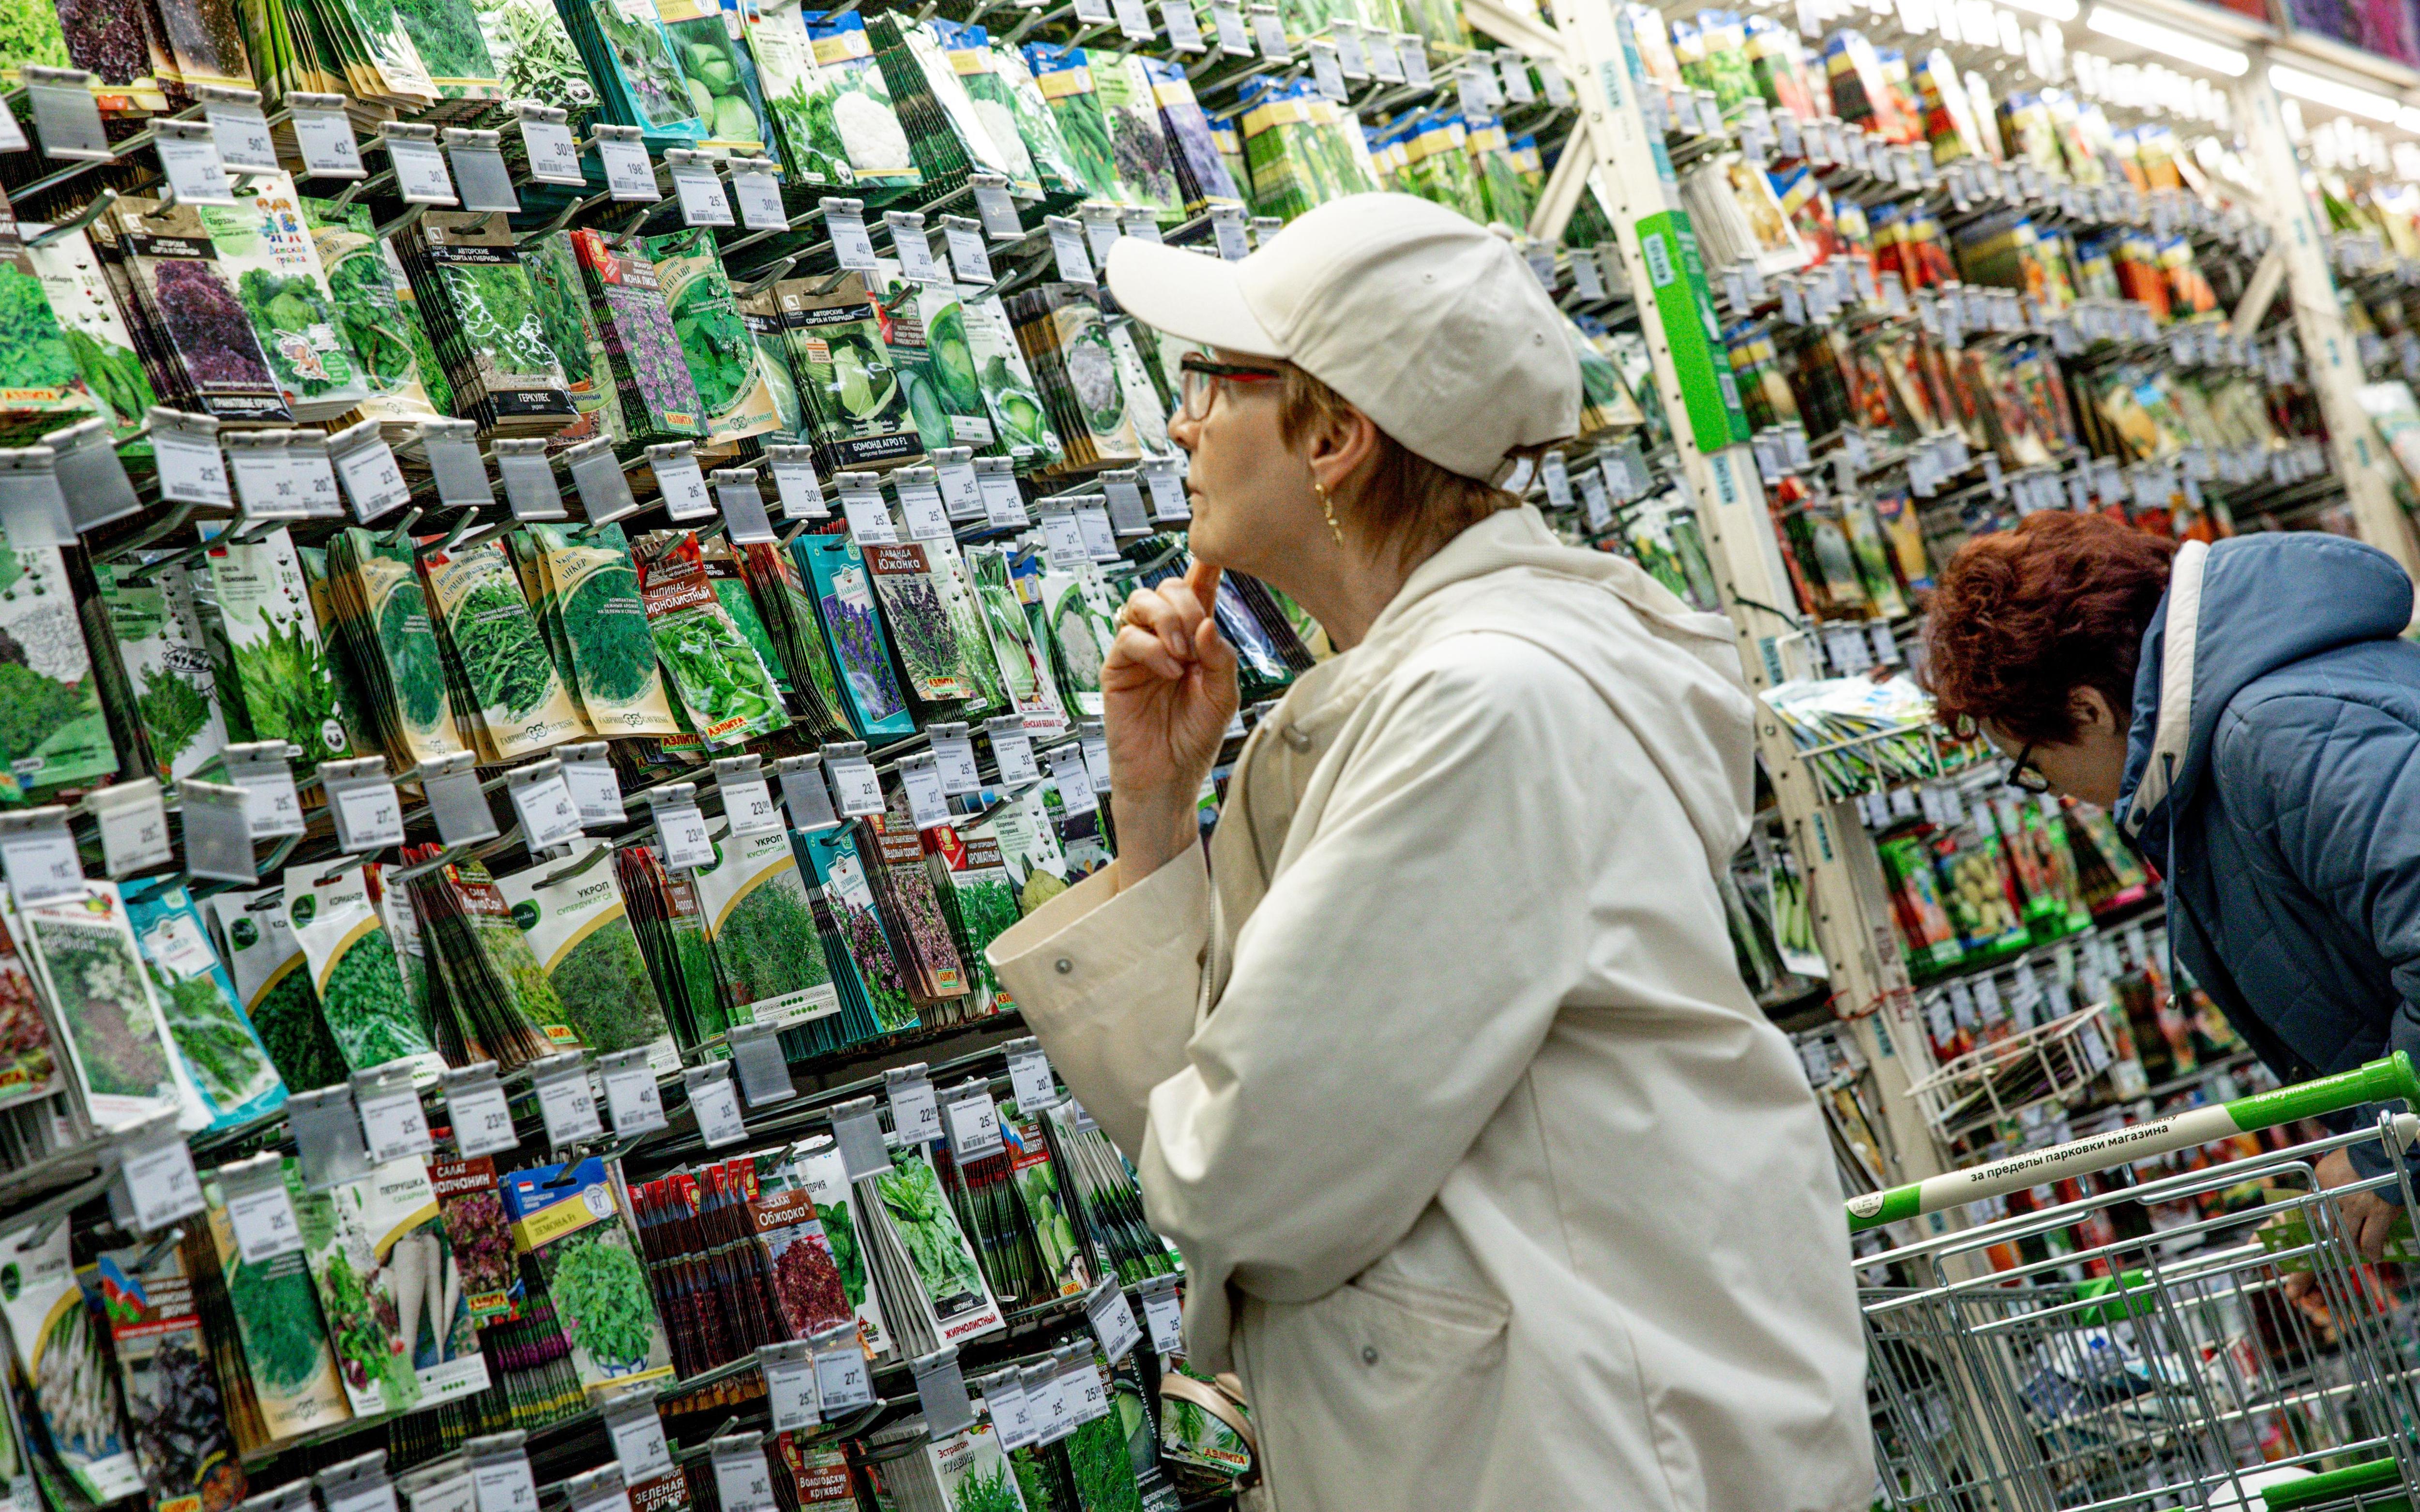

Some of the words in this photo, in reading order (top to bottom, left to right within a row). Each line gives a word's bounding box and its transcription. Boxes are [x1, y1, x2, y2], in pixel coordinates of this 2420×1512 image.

[622, 274, 641, 284] МОНА
[642, 278, 659, 288] ЛИЗА
[813, 309, 843, 318] АВТОРСКИЕ
[518, 392, 550, 403] ГЕРКУЛЕС
[667, 414, 694, 426] АЭЛИТА
[853, 442, 878, 451] БОМОНД
[879, 440, 895, 449] АГРО
[879, 548, 911, 558] ЛАВАНДА
[878, 557, 921, 570] Южанка
[650, 581, 685, 598] ШПИНАТ
[929, 677, 955, 687] АЭЛИТА
[598, 715, 624, 725] ГАВРИШ
[641, 715, 667, 724] GAVRISH
[707, 716, 748, 738] АЭЛИТА
[663, 733, 702, 746] АЭЛИТА
[999, 827, 1019, 836] лягушка
[755, 834, 783, 848] УКРОП
[747, 843, 786, 859] КУСТИСТЫЙ
[968, 851, 1001, 865] АРОМАТНЫЙ
[577, 881, 609, 898] УКРОП
[938, 972, 955, 982] АЭЛИТА
[2255, 1075, 2344, 1103] leroymerlin.ru
[1970, 1171, 1984, 1182] за
[1987, 1156, 2043, 1179] пределы
[2045, 1140, 2106, 1162] парковки
[2107, 1124, 2169, 1147] магазина
[437, 1162, 467, 1177] САЛАТ
[379, 1177, 427, 1197] ПЕТРУШКА
[769, 1195, 791, 1208] САЛАТ
[759, 1205, 805, 1227] Обжорка
[1062, 1283, 1080, 1294] АЭЛИТА
[953, 1299, 974, 1312] ШПИНАТ
[944, 1314, 997, 1340] ЖИРНОЛИСТНЫЙ
[937, 1439, 969, 1459] Эстрагон
[942, 1451, 975, 1474] ГУДВИН
[1204, 1447, 1246, 1466] АЭЛИТА
[800, 1472, 847, 1489] Вологодские
[635, 1479, 685, 1505] ЗЕЛЕНАЯ
